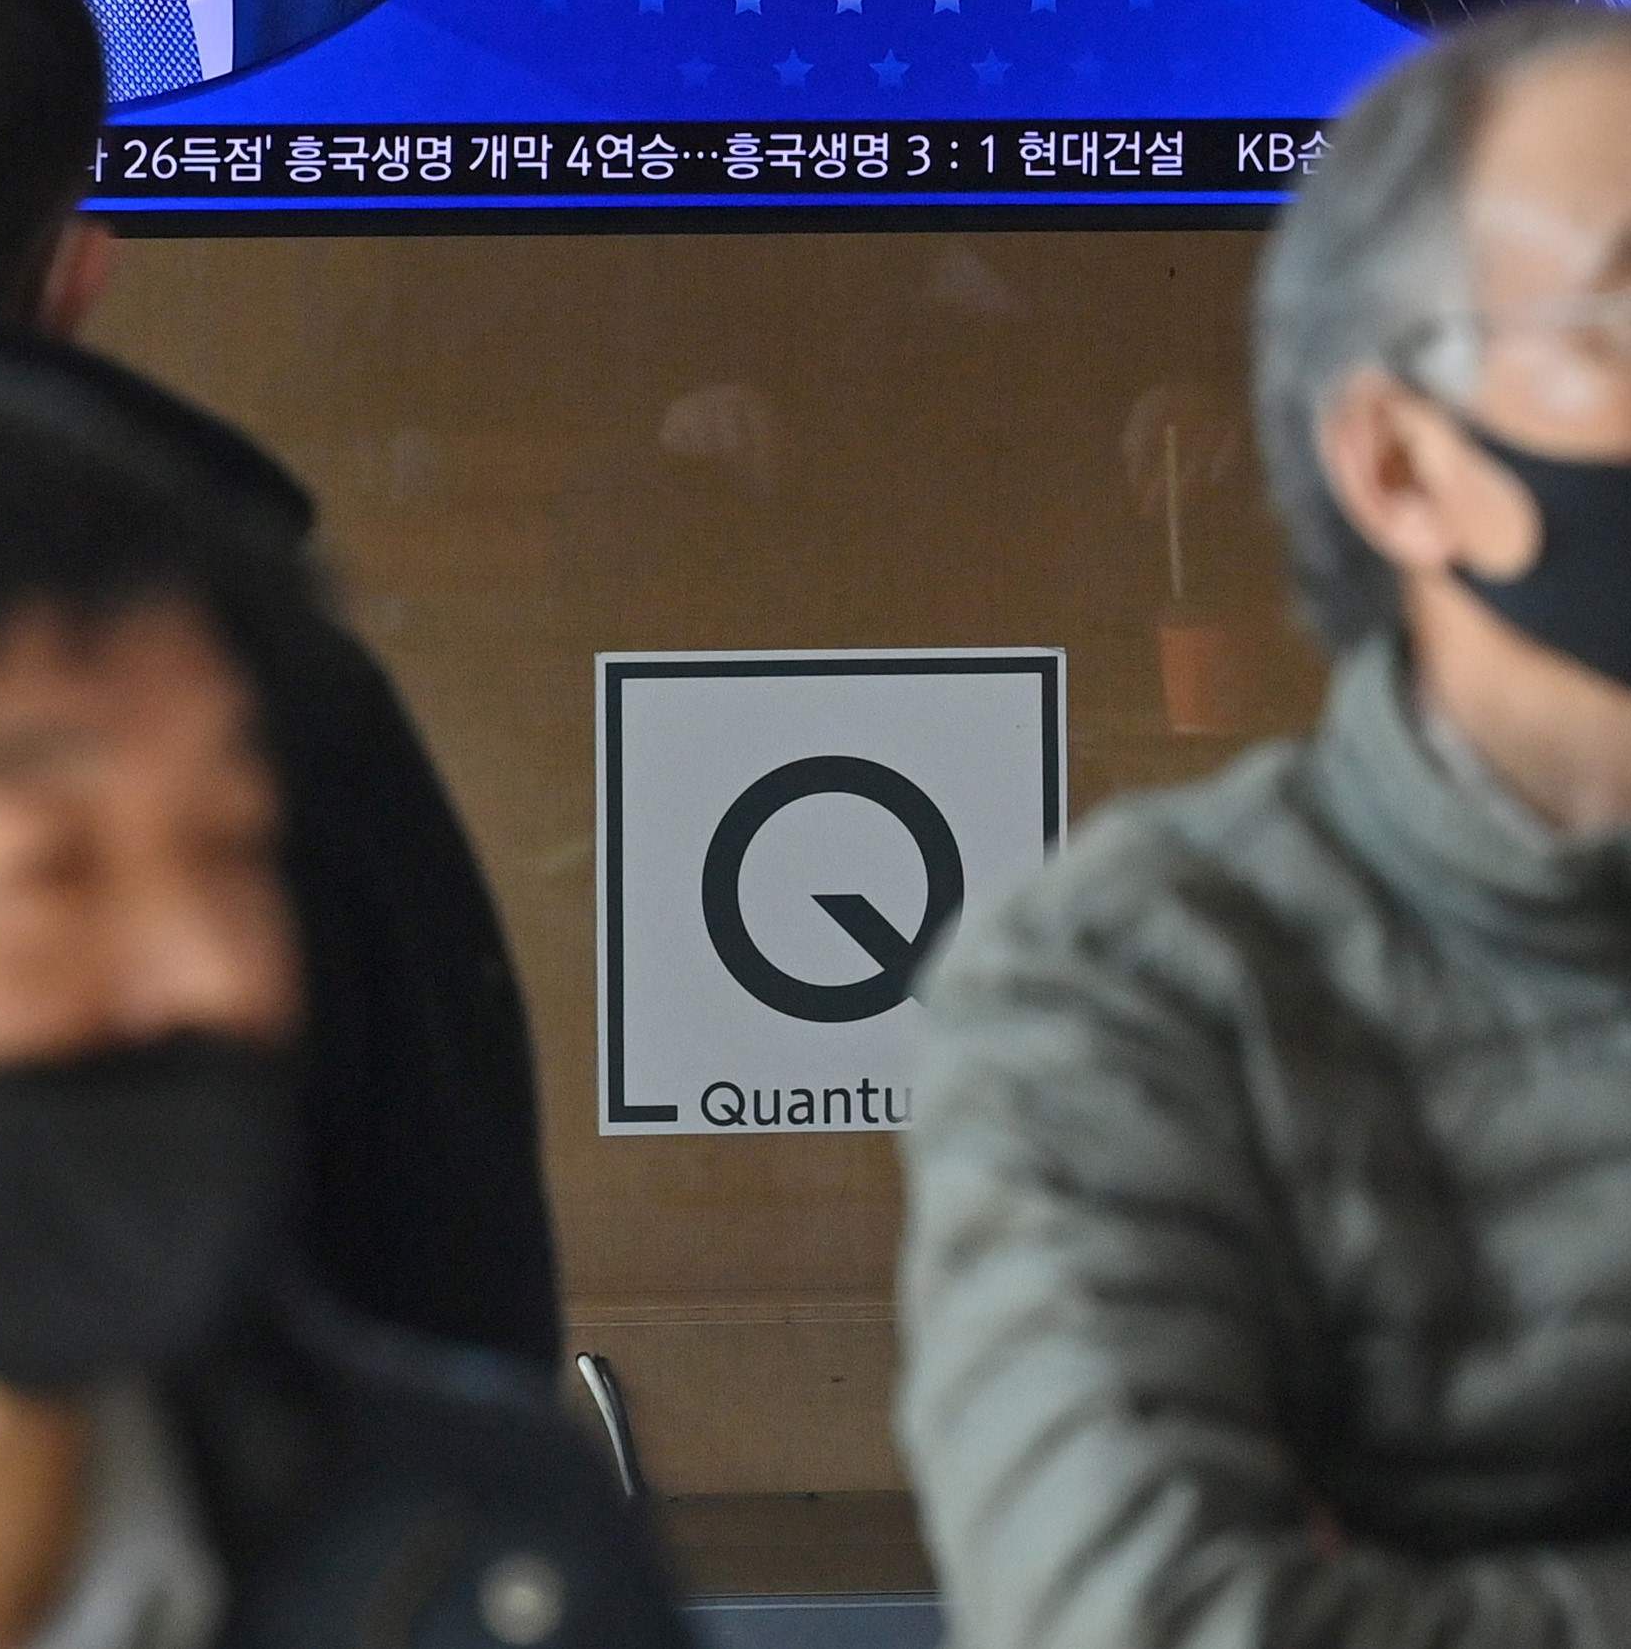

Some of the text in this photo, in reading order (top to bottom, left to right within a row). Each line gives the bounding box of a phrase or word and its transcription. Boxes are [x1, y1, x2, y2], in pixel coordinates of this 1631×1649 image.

[122, 134, 272, 184] 26득점'
[284, 133, 453, 183] 흥국생명
[469, 133, 553, 182] 개막
[906, 135, 931, 177] 3
[979, 133, 995, 174] 1
[1018, 130, 1185, 177] 현대건설
[701, 755, 965, 1024] Q
[700, 1077, 913, 1127] Quantu
